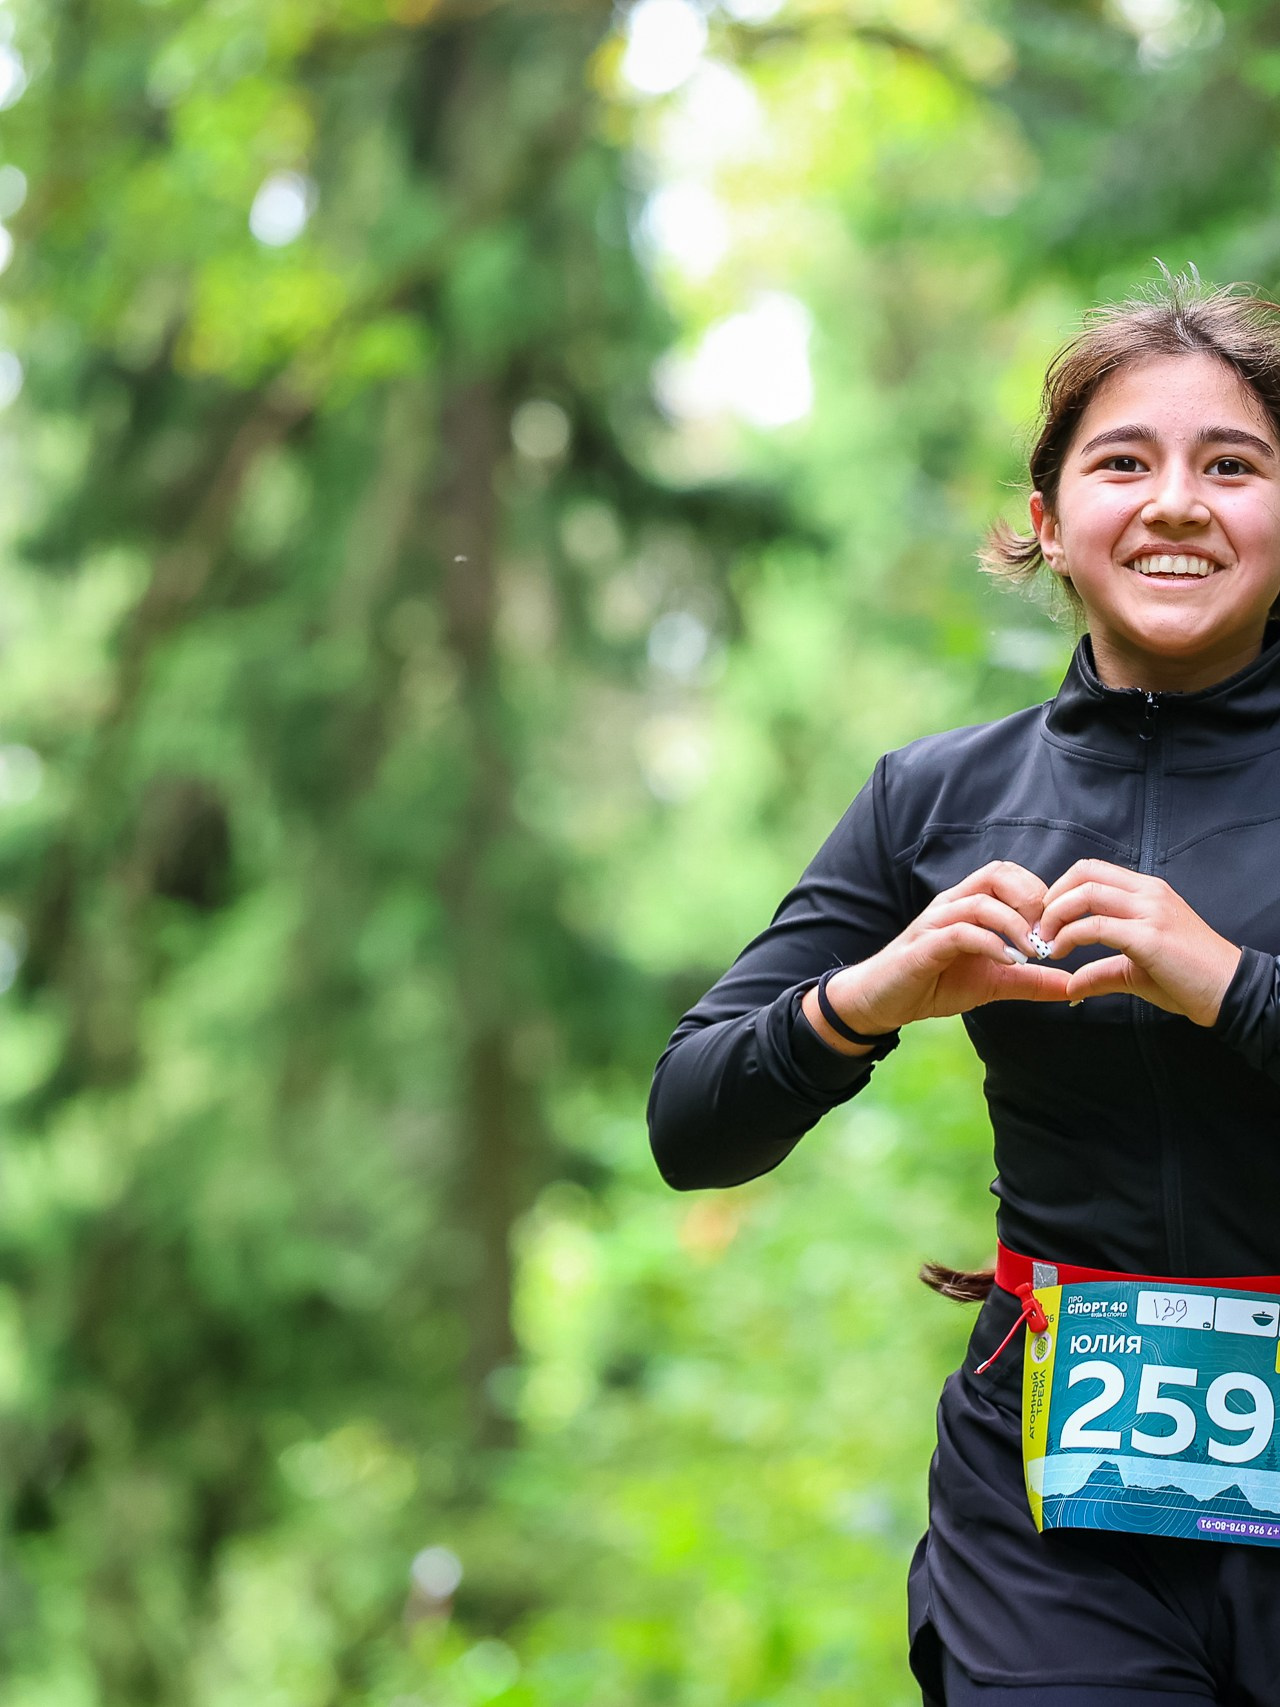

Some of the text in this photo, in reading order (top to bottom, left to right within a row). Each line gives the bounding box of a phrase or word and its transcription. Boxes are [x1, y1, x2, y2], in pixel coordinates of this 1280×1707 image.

[1067, 1301, 1128, 1315] СПОРТ 40
[1069, 1334, 1142, 1356] ЮЛИЯ
[1029, 1371, 1039, 1440] АТОМНЫЙ
[1059, 1359, 1276, 1464] 259
[1200, 1519, 1247, 1533] 878-80-91
[1248, 1524, 1265, 1535] 926
[1266, 1527, 1279, 1535] +7
